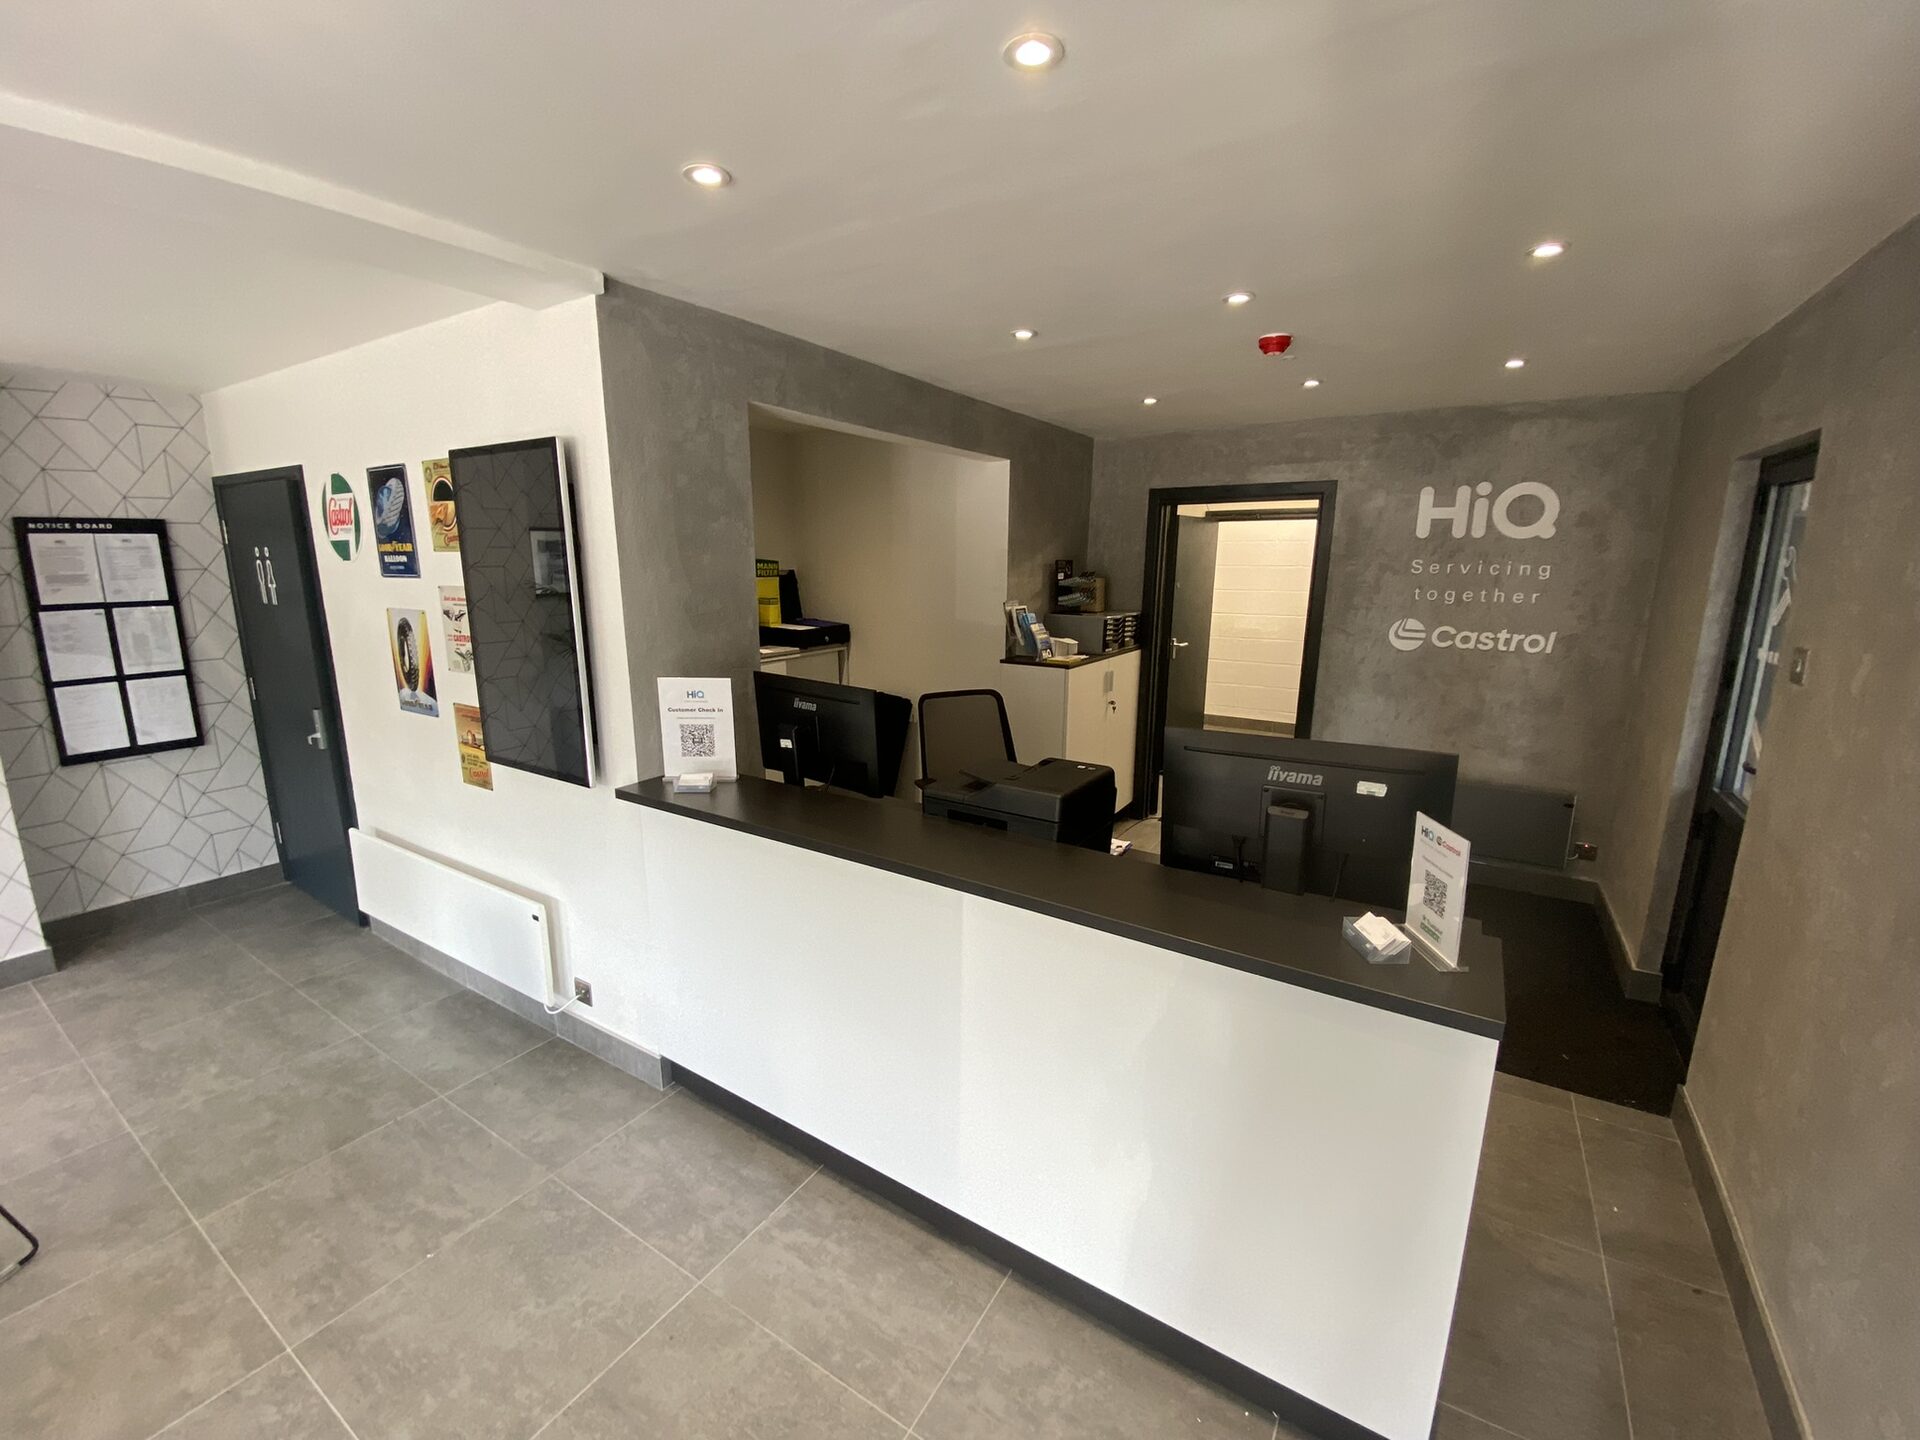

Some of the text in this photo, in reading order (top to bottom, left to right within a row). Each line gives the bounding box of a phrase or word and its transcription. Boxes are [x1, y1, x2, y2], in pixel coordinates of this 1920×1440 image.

[328, 497, 353, 536] Castrol
[1415, 481, 1560, 539] HiQ
[28, 522, 71, 530] NOTICE
[756, 562, 779, 570] MANN
[1411, 559, 1552, 580] Servicing
[1414, 587, 1541, 605] together
[1431, 625, 1558, 654] Castrol
[686, 690, 705, 699] HiQ
[793, 697, 817, 712] iiyama
[1267, 765, 1324, 786] iiyama
[1421, 825, 1435, 842] HiQ
